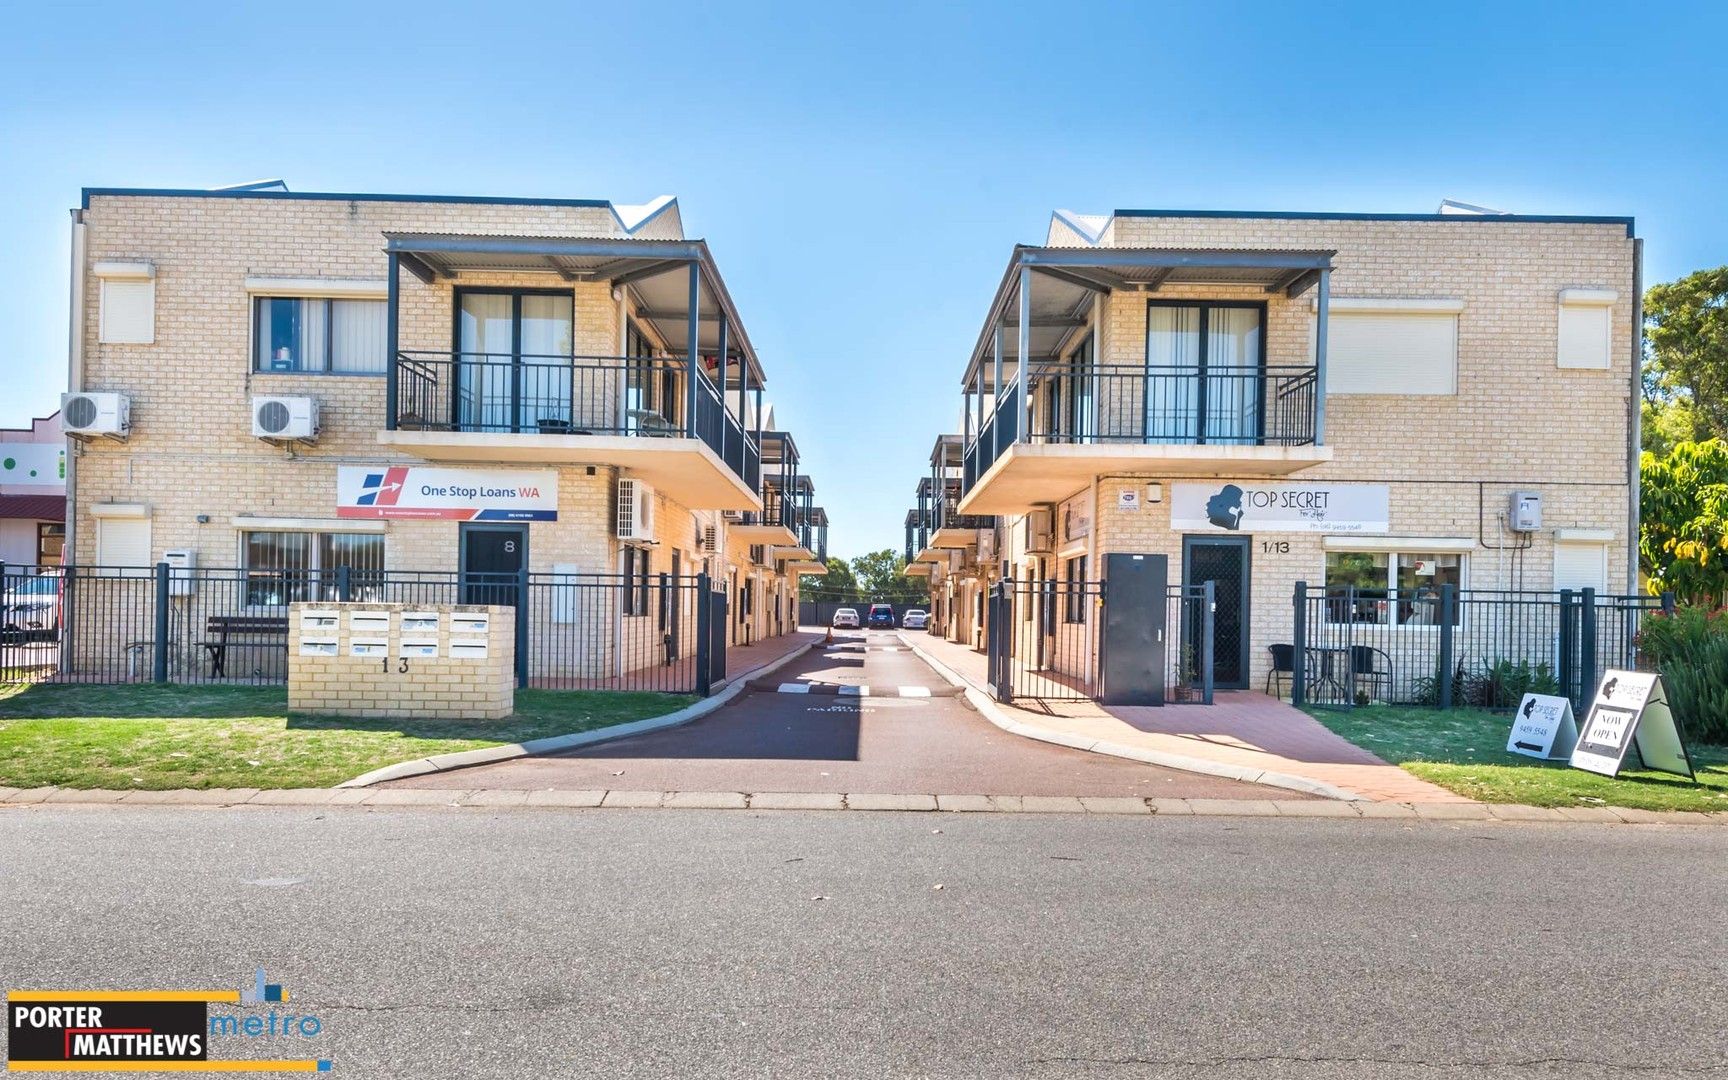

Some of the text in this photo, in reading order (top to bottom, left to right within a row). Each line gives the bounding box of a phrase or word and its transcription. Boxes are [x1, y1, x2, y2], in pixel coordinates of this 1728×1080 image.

[421, 485, 540, 500] One Stop Loans WA
[1247, 491, 1330, 509] TOP SECRET
[504, 540, 515, 553] 8
[1262, 541, 1290, 554] 1/13
[1602, 714, 1622, 725] NOW
[1593, 728, 1618, 740] OPEN
